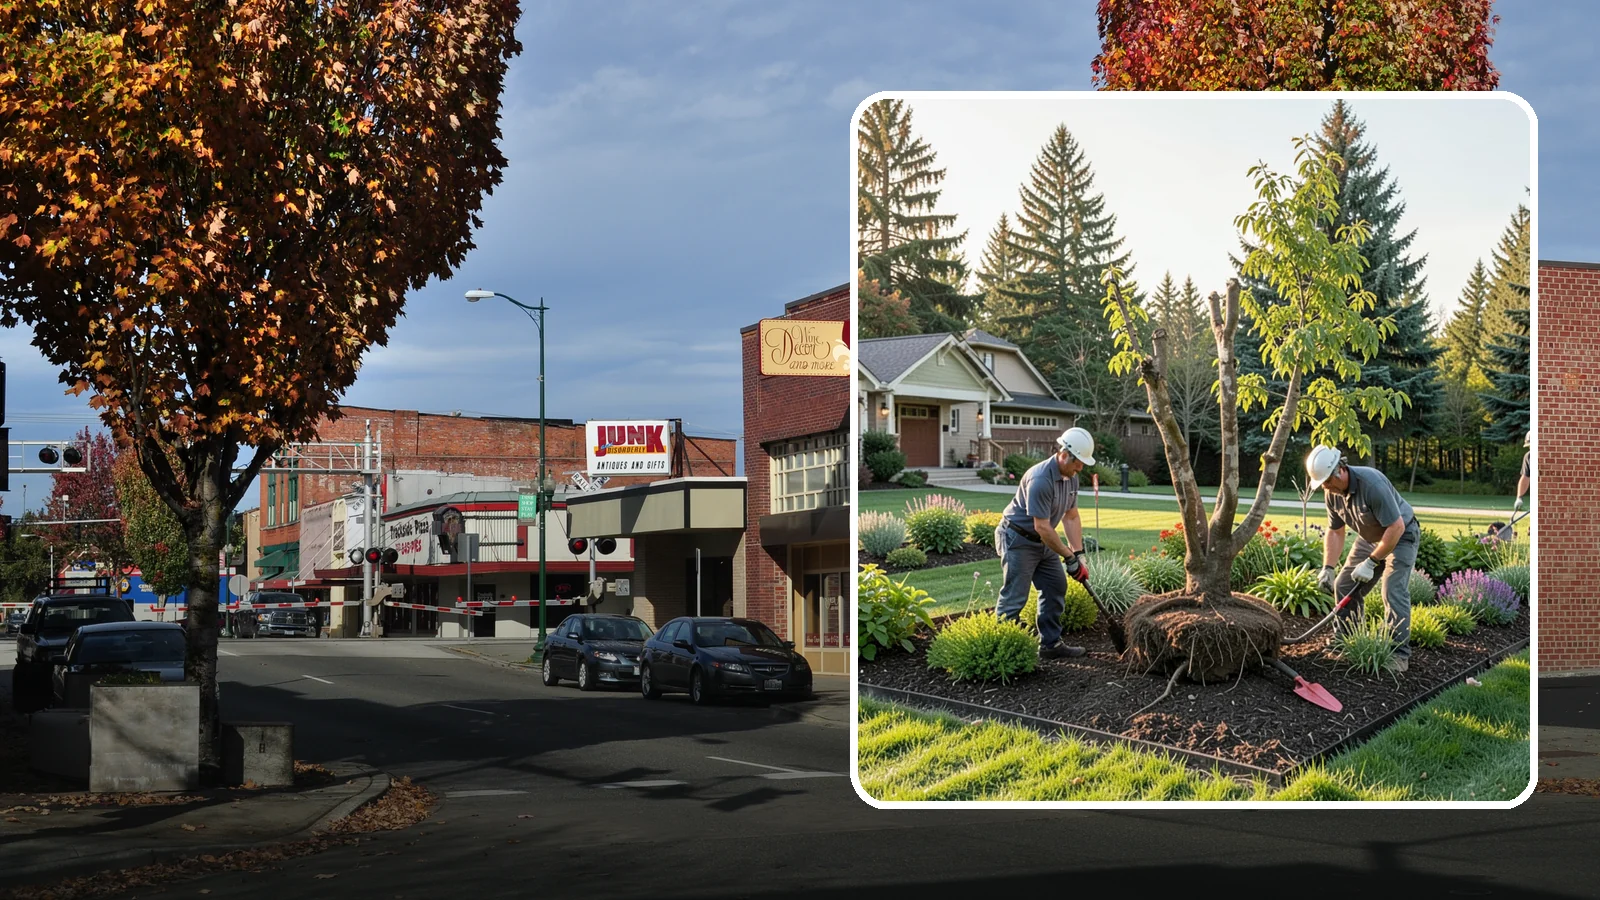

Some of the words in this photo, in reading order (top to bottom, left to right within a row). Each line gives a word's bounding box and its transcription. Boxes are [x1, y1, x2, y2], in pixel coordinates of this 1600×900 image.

[764, 327, 831, 365] Decor
[595, 425, 665, 457] JUNK
[607, 446, 646, 454] DISORDERLY
[597, 461, 628, 470] ANTIQUES
[631, 461, 644, 470] AND
[647, 460, 665, 470] GIFTS
[390, 521, 413, 540] Trackside
[414, 519, 429, 535] Pizza
